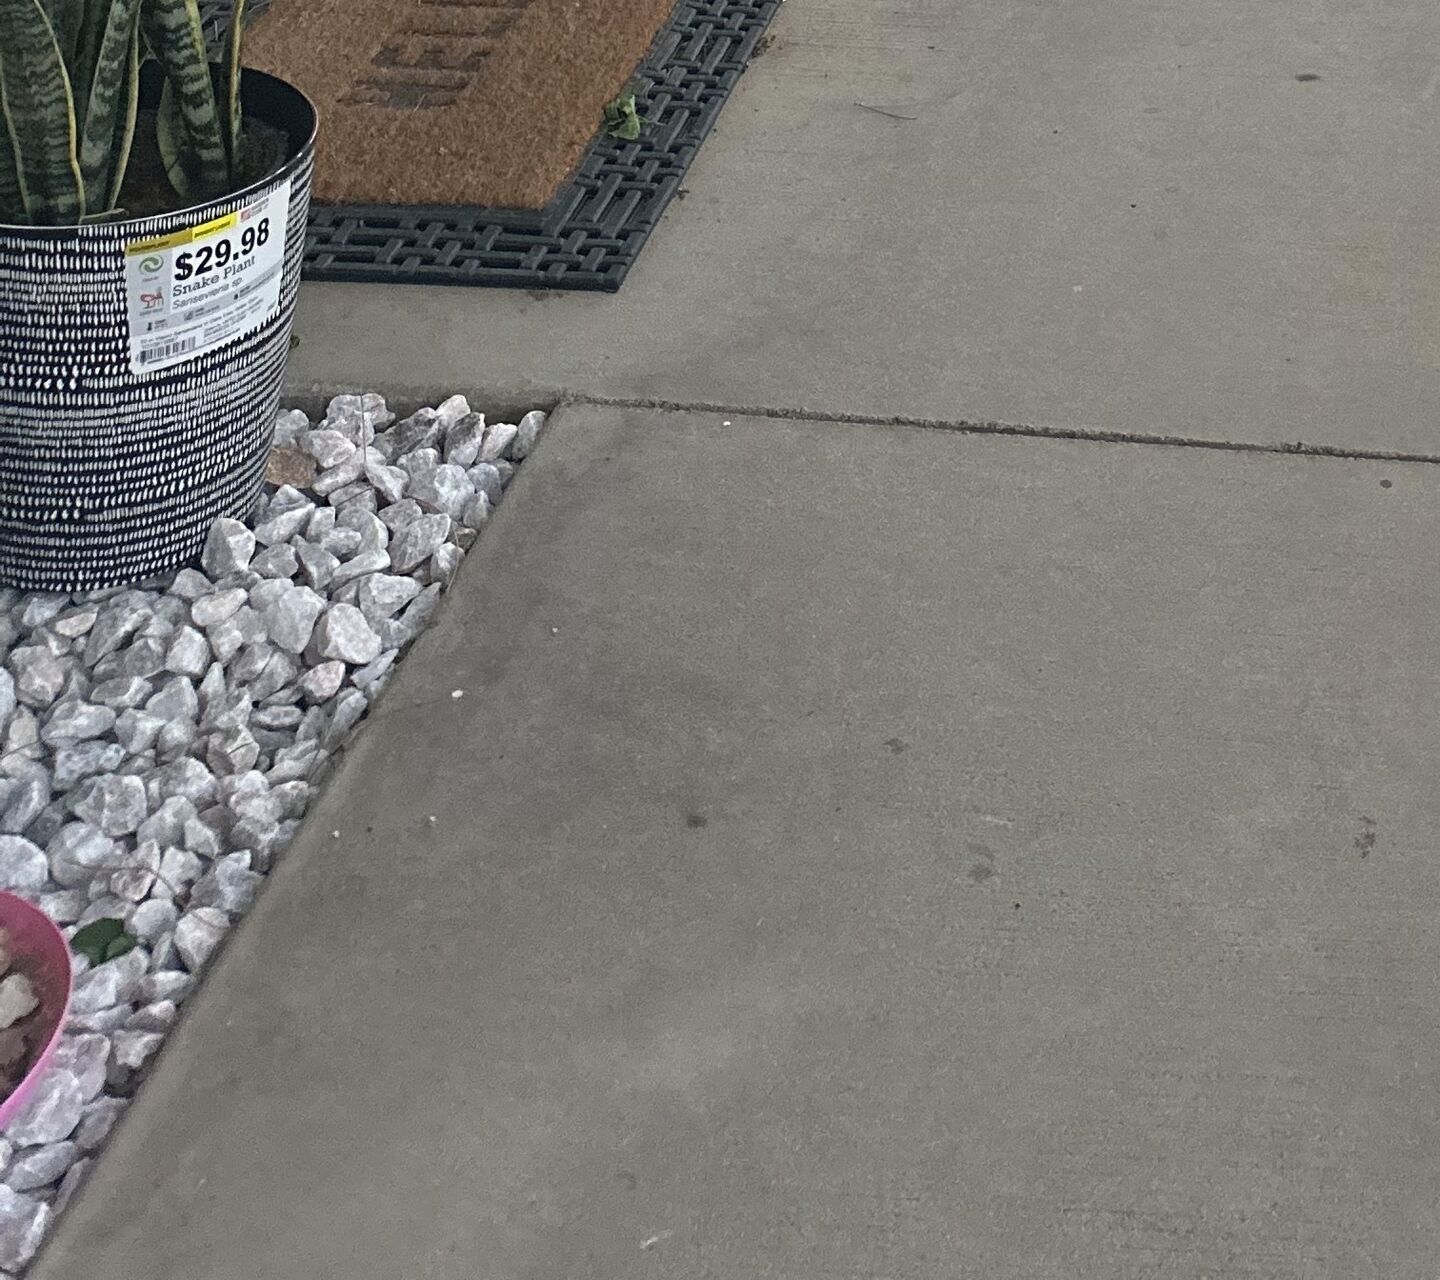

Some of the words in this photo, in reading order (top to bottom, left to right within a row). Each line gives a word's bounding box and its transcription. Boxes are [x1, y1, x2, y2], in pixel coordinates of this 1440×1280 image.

[174, 217, 270, 281] $29.98
[172, 275, 220, 297] Snake
[223, 255, 256, 280] Plant
